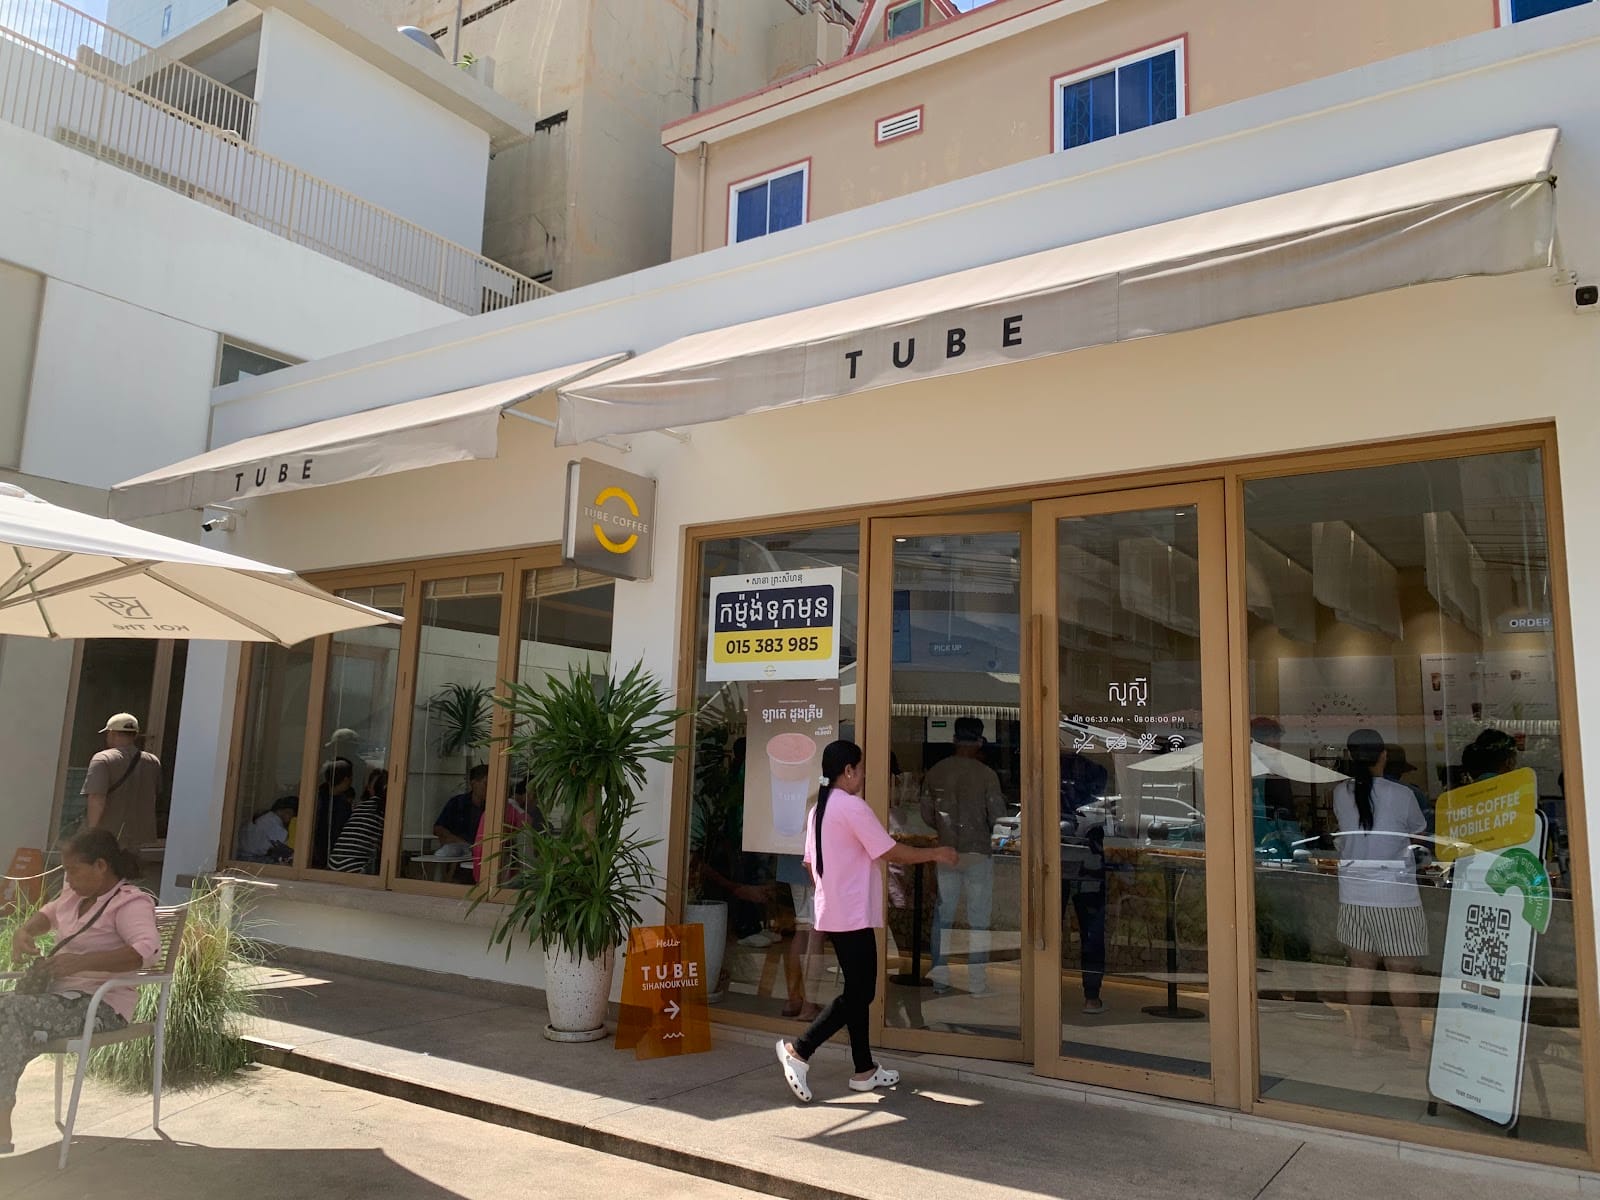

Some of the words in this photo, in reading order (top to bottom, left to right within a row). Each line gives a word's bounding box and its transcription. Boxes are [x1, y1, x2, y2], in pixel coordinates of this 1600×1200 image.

[845, 314, 1023, 379] TUBE
[235, 459, 313, 492] TUBE
[584, 507, 609, 522] TUBE
[612, 516, 649, 534] COFFEE
[1509, 617, 1551, 628] ORDER
[726, 640, 751, 654] 015
[755, 638, 783, 653] 383
[788, 636, 818, 652] 985
[1144, 715, 1169, 723] 08:00
[1172, 715, 1185, 723] PM
[1446, 806, 1473, 822] TUBE
[1476, 791, 1520, 815] COFFEE
[1449, 818, 1490, 841] MOBILE
[1494, 811, 1517, 828] APP
[656, 939, 680, 948] Hello
[641, 962, 698, 981] TUBE
[642, 979, 699, 991] SIHANOUKVILLE
